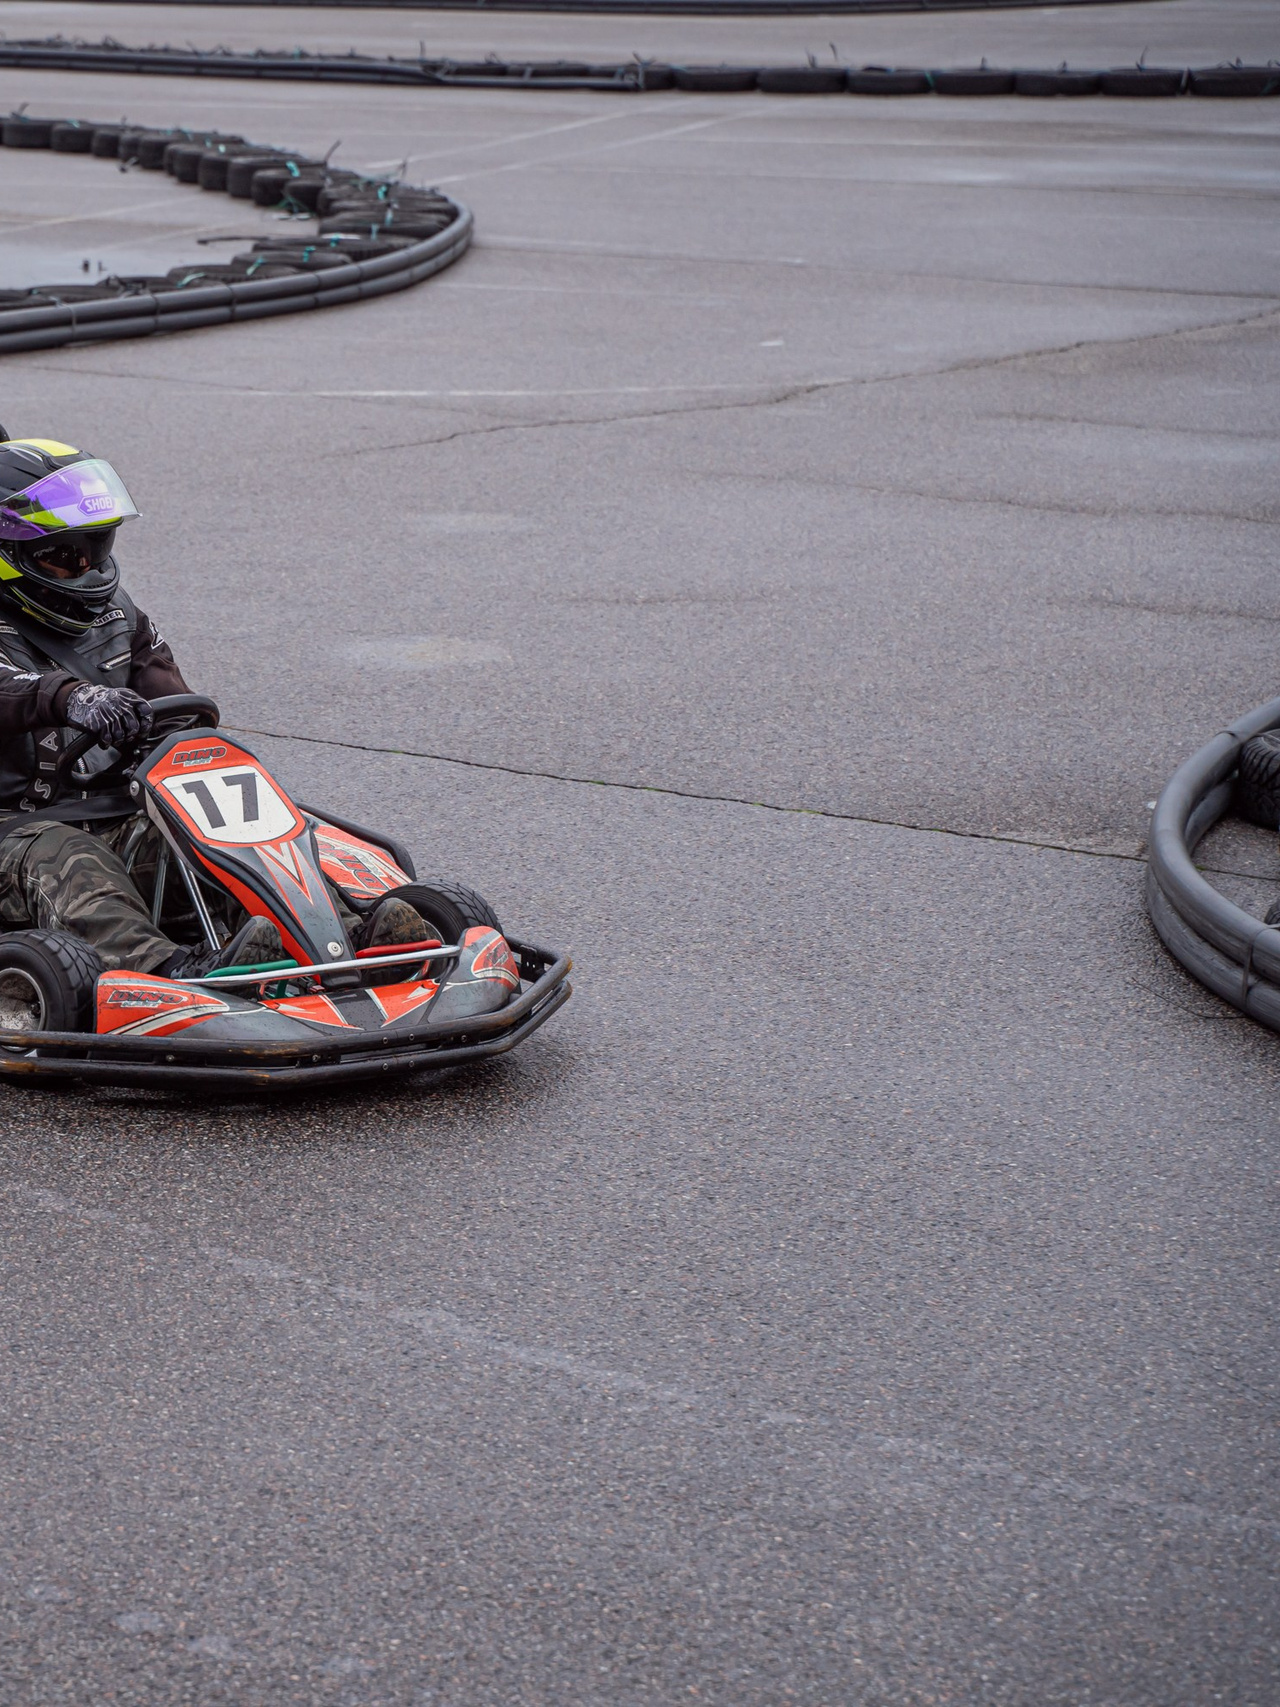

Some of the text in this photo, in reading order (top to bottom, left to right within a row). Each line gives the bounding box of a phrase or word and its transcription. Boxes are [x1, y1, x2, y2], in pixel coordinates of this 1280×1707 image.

[94, 609, 124, 625] MBER
[172, 746, 227, 764] DINO
[181, 772, 260, 830] 17
[108, 991, 184, 1004] DINO
